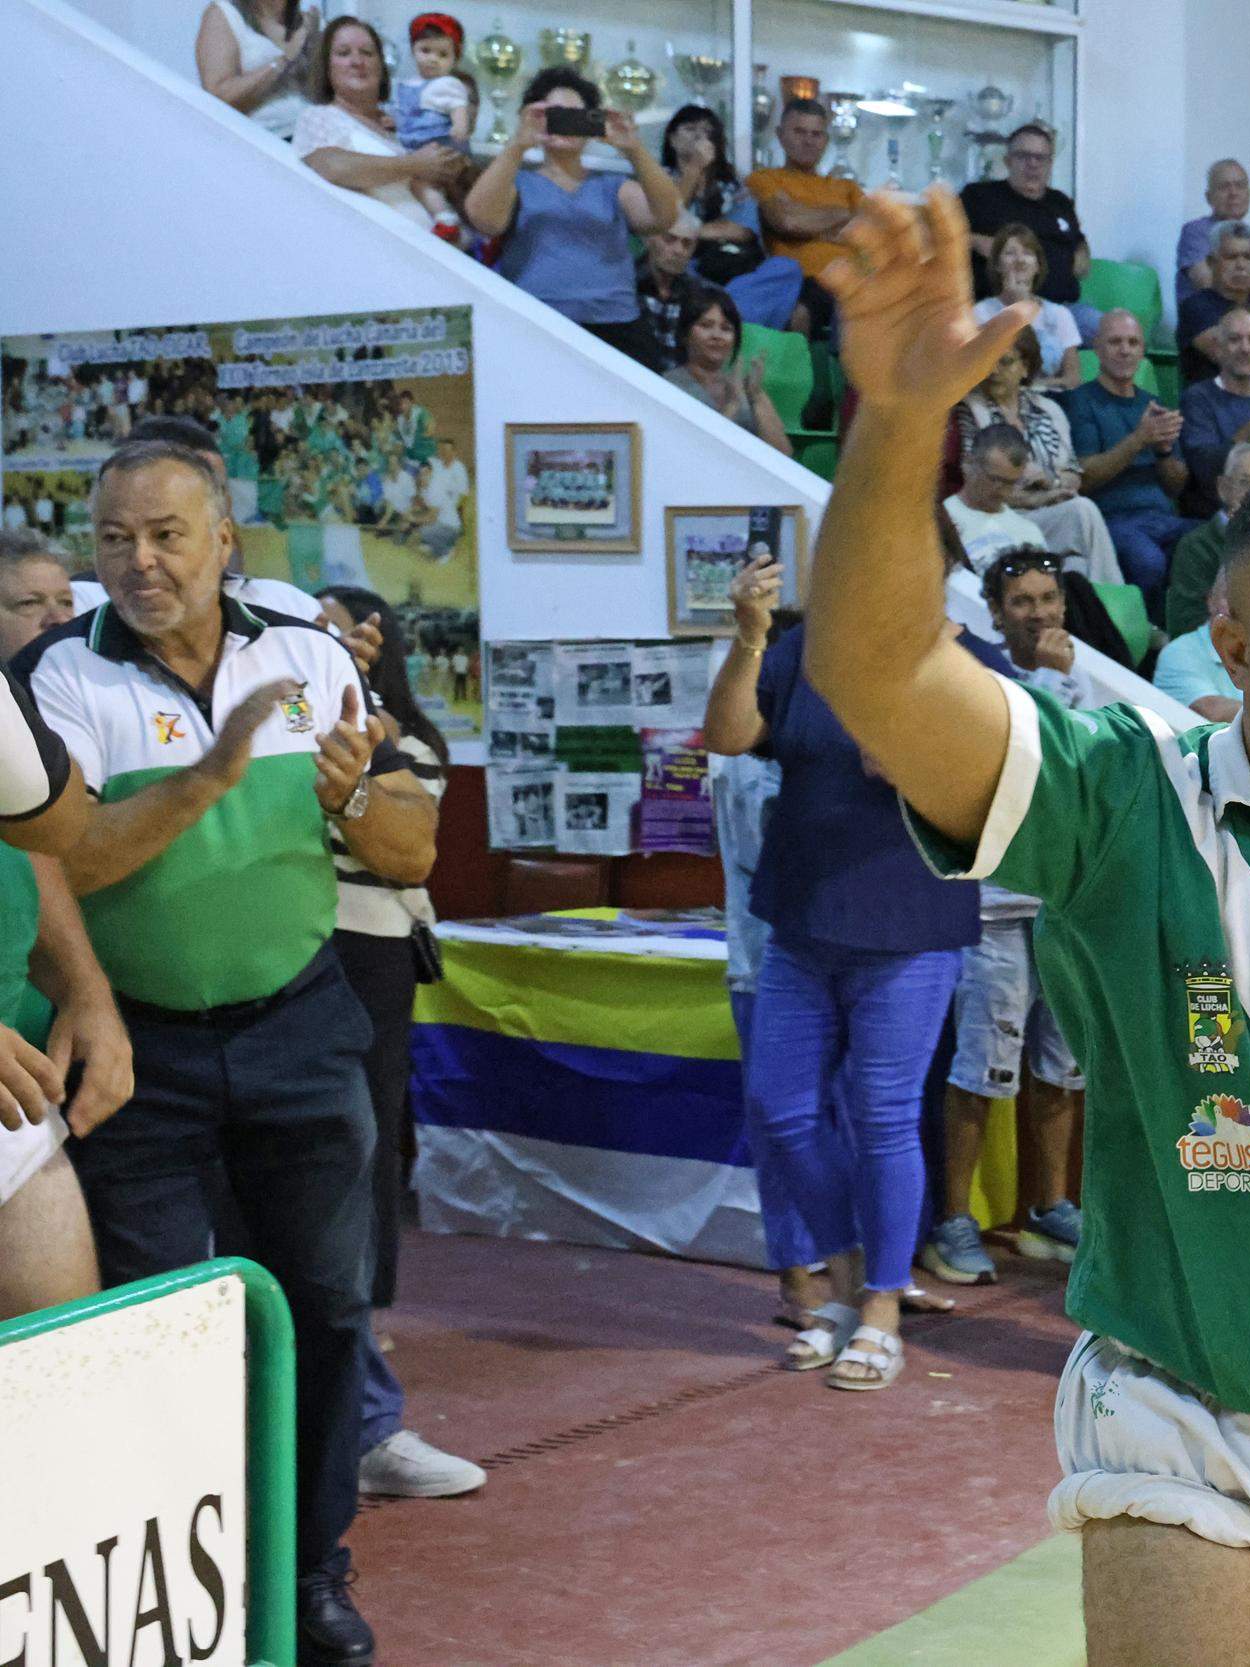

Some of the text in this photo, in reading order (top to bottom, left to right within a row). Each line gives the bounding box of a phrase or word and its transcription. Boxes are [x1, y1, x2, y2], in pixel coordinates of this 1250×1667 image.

[1196, 994, 1218, 1003] CLUB
[1201, 1002, 1229, 1011] LUCHA
[1200, 1054, 1227, 1063] TAO
